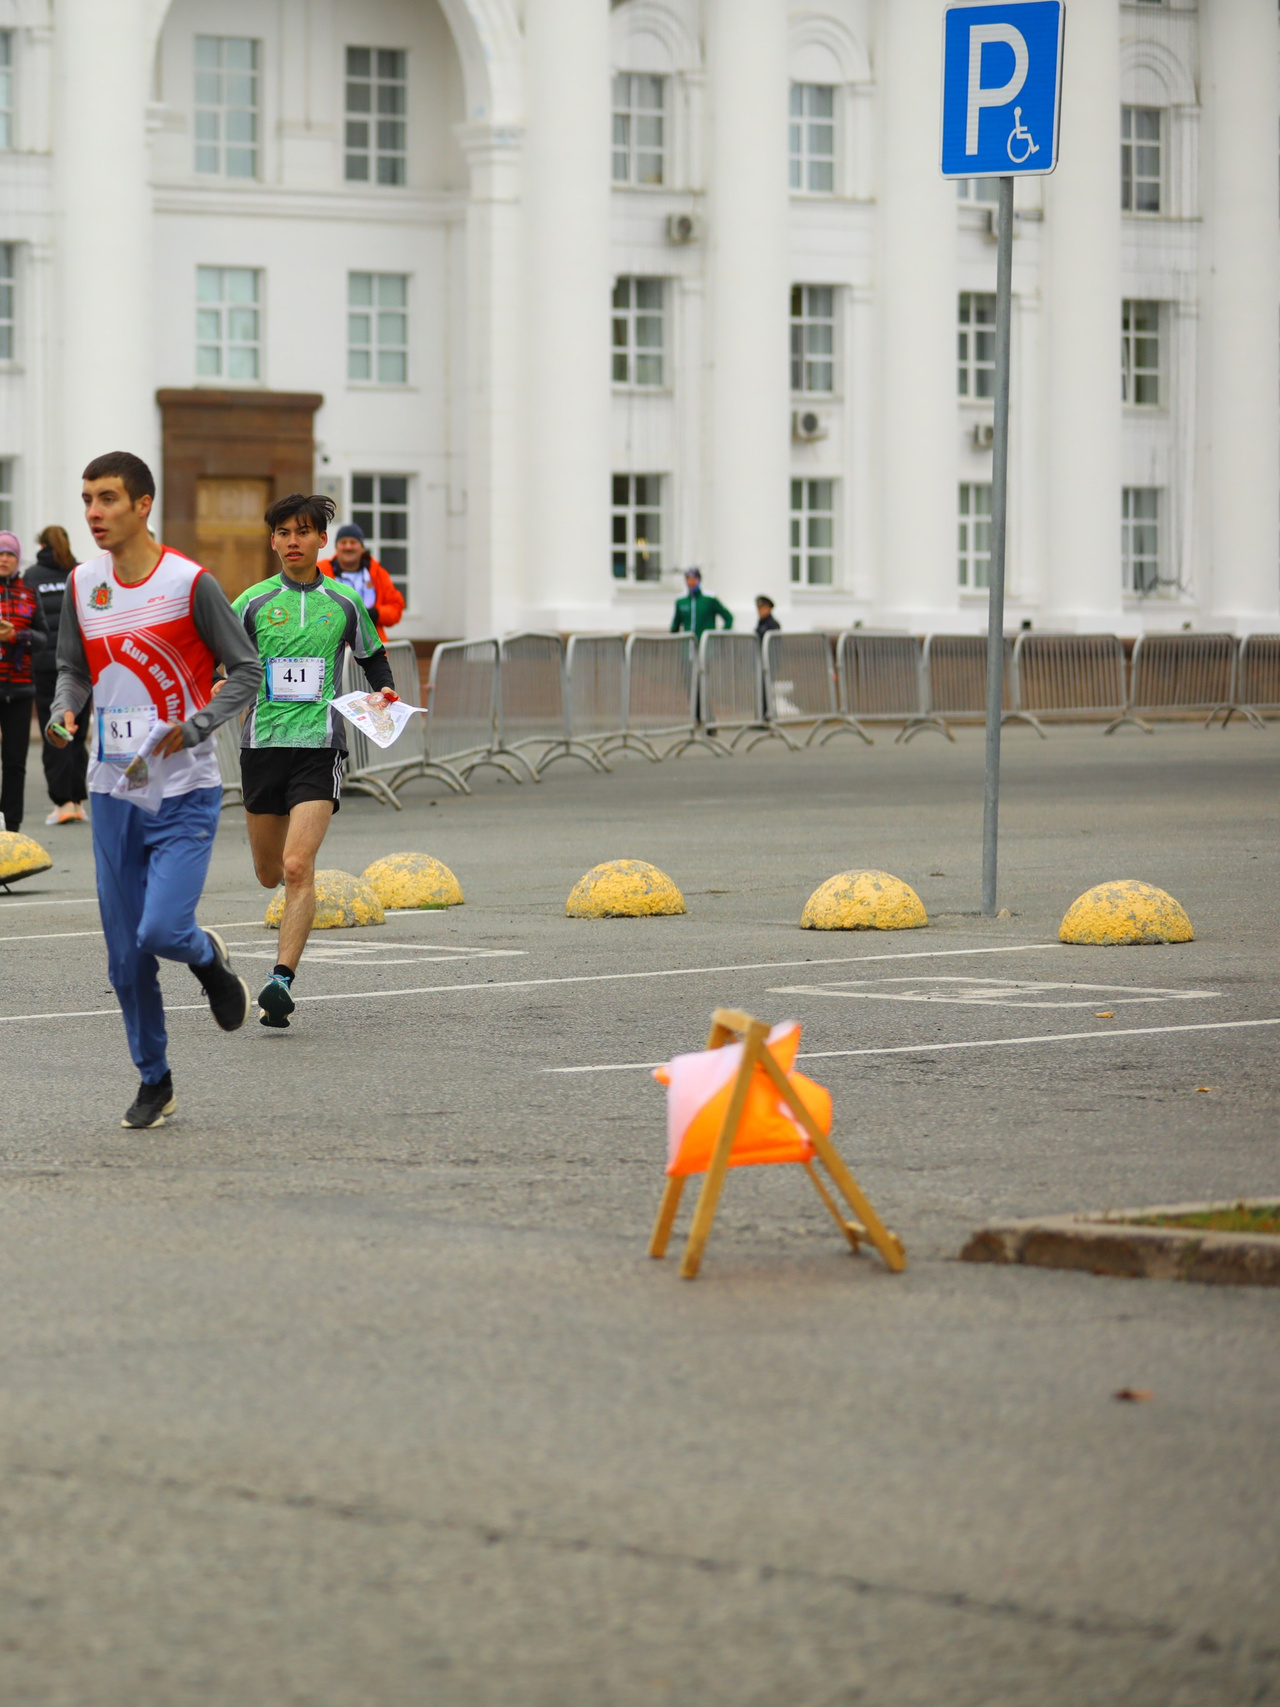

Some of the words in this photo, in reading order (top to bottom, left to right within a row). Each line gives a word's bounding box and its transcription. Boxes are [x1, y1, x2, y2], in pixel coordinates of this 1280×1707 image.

[965, 23, 1029, 156] P
[121, 638, 149, 665] Run
[148, 664, 175, 690] and
[283, 668, 306, 683] 4.1
[110, 720, 133, 738] 8.1
